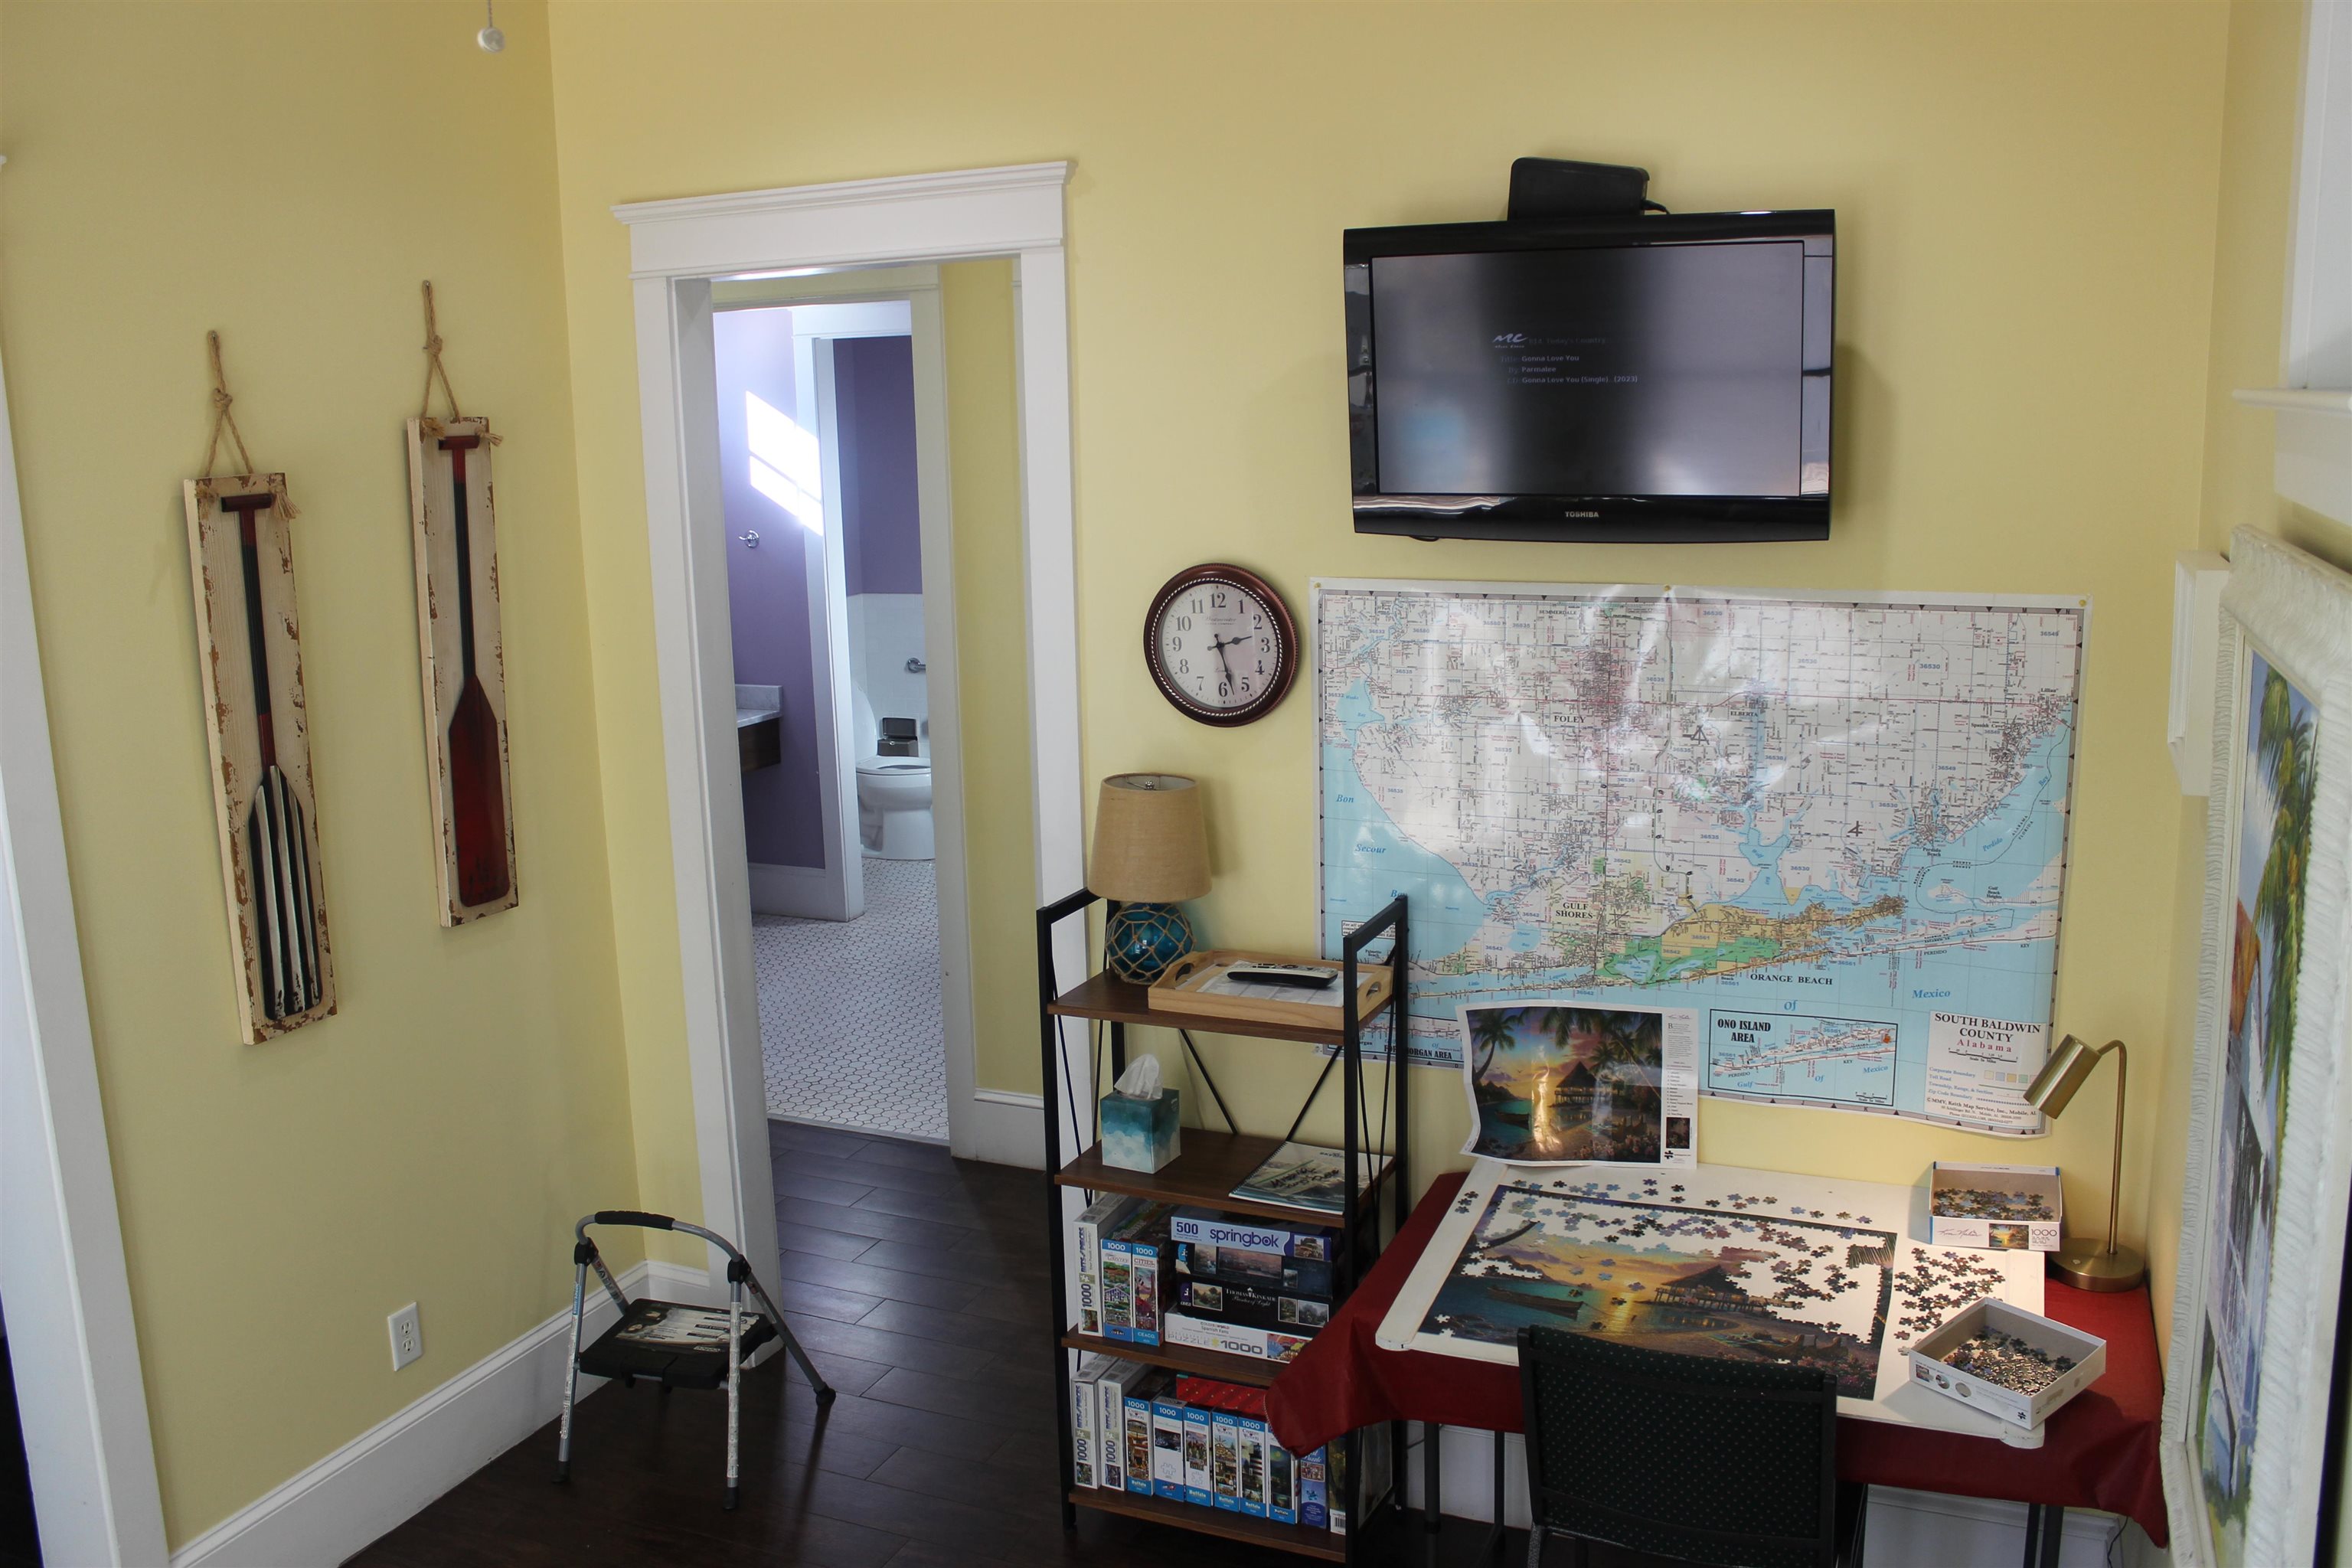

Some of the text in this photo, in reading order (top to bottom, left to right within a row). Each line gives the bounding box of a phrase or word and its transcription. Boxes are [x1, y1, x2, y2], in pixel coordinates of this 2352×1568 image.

[1614, 374, 1638, 383] (2023)
[1191, 599, 1204, 613] 11
[1210, 593, 1226, 608] 12
[1238, 599, 1245, 613] 1
[1176, 616, 1191, 631] 10
[1253, 614, 1263, 629] 2
[1172, 636, 1182, 651] 9
[1261, 637, 1270, 653] 3
[1180, 658, 1189, 674] 8
[1256, 660, 1265, 675] 4
[1197, 676, 1204, 691] 7
[1218, 682, 1228, 697] 6
[1241, 677, 1250, 692] 5
[1553, 715, 1586, 724] FOLEY
[1336, 794, 1354, 803] Bon
[1354, 844, 1387, 854] Secour
[1982, 838, 2003, 852] Perdido
[1563, 902, 1589, 910] GULF
[1555, 910, 1593, 919] SHORES
[1750, 973, 1833, 986] ORANGE BEACH
[1912, 988, 1951, 999] Mexico
[1717, 1019, 1771, 1032] ONO ISLAND
[1935, 1012, 2041, 1034] SOUTH BALDWIN
[1730, 1033, 1755, 1043] AREA
[1959, 1027, 2014, 1043] COUNTY
[1957, 1039, 2012, 1053] Alabama
[1863, 1065, 1888, 1073] Mexico
[1929, 1067, 1952, 1075] Corporate
[1176, 1222, 1199, 1234] 500
[1210, 1228, 1279, 1248] springbok
[2031, 1229, 2057, 1237] 1000
[1107, 1242, 1125, 1251] 1000
[1135, 1247, 1154, 1256] 1000
[1080, 1283, 1092, 1308] 1000
[1226, 1288, 1276, 1302] THOMAS KINKADE
[1167, 1334, 1210, 1347] PUZZLE
[1220, 1340, 1263, 1356] 1000
[1127, 1400, 1145, 1410] 1000
[1159, 1406, 1176, 1416] 1000
[1187, 1412, 1204, 1422] 1000
[1215, 1416, 1233, 1425] 1000
[1242, 1420, 1260, 1429] 1000
[1076, 1439, 1087, 1462] 1000
[1106, 1440, 1116, 1463] 1000
